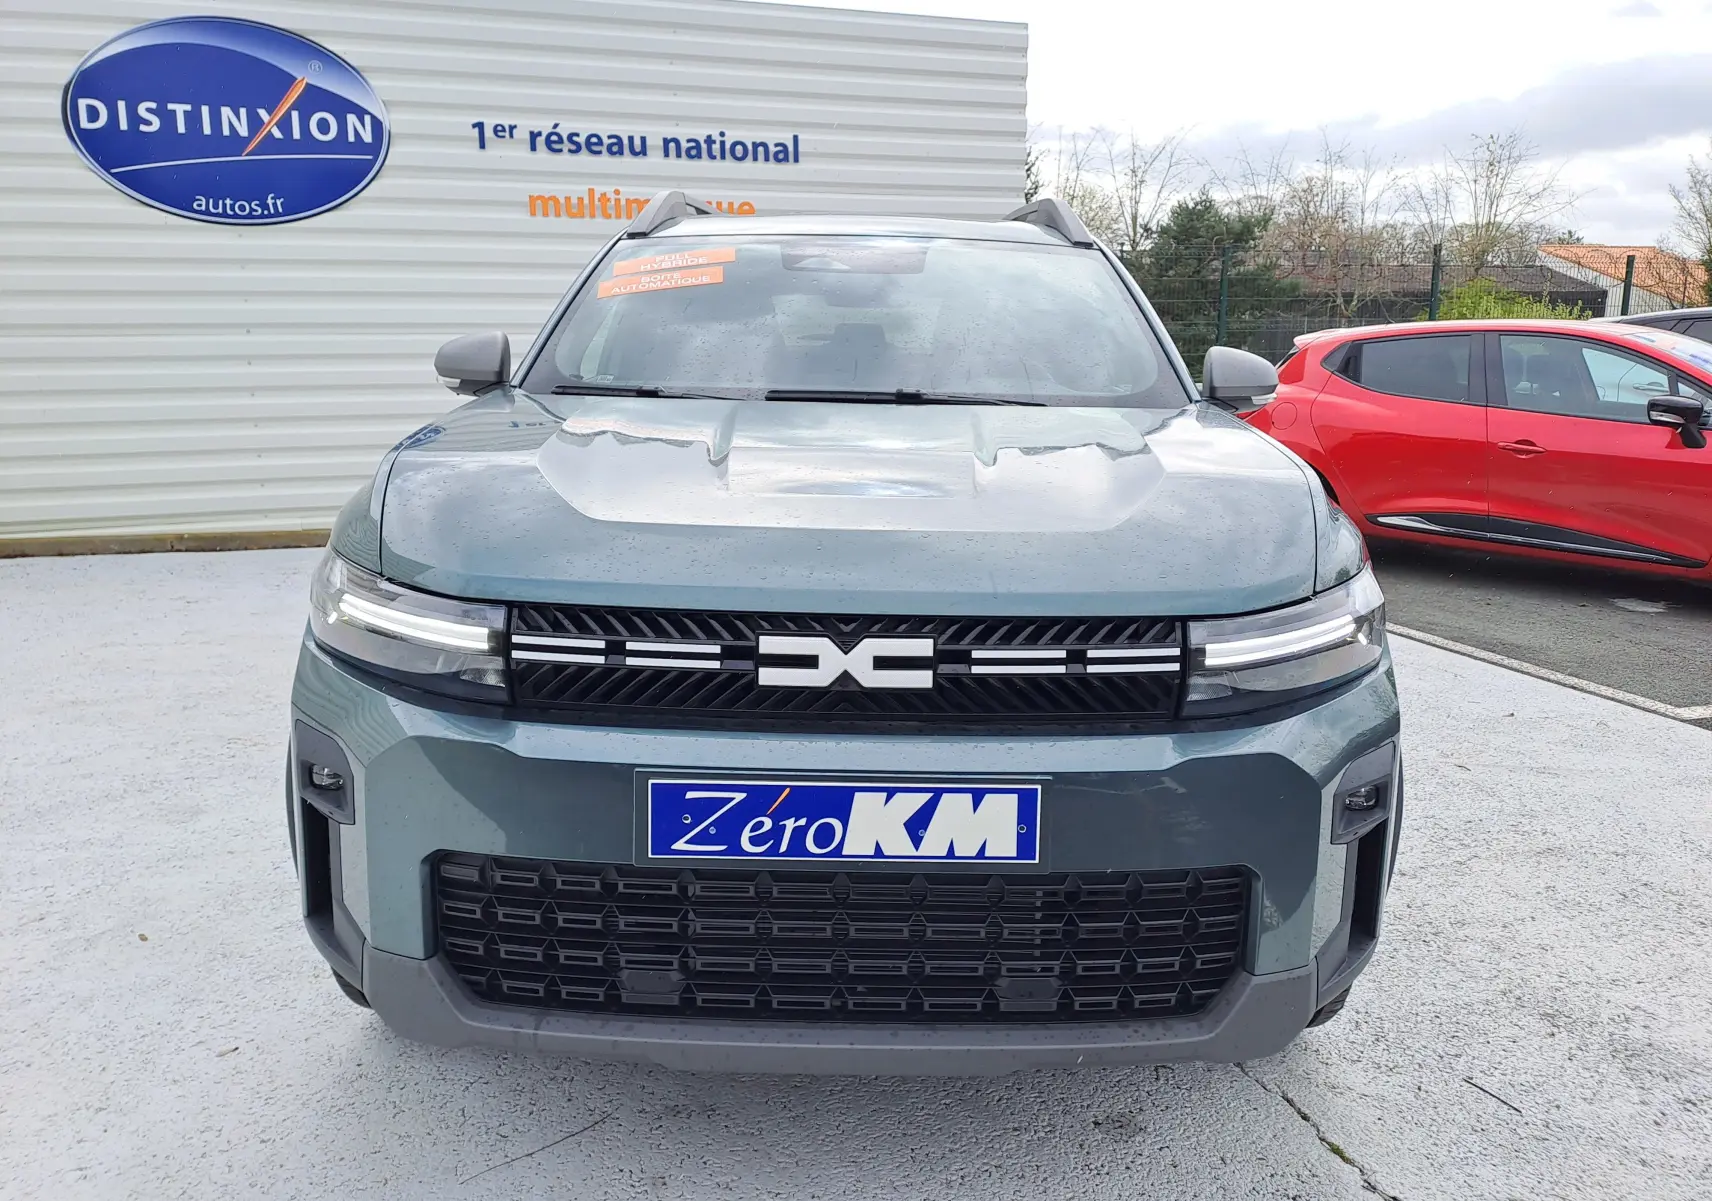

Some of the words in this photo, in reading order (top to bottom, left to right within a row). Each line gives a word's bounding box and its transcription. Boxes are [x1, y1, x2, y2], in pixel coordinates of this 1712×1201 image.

[77, 97, 373, 143] DISTINXION
[471, 121, 518, 150] 1er
[528, 123, 648, 157] réseau
[662, 131, 801, 164] national
[192, 193, 284, 217] autos.fr
[640, 256, 708, 271] HYBRIDE
[611, 276, 710, 293] AUTOMATIQUE
